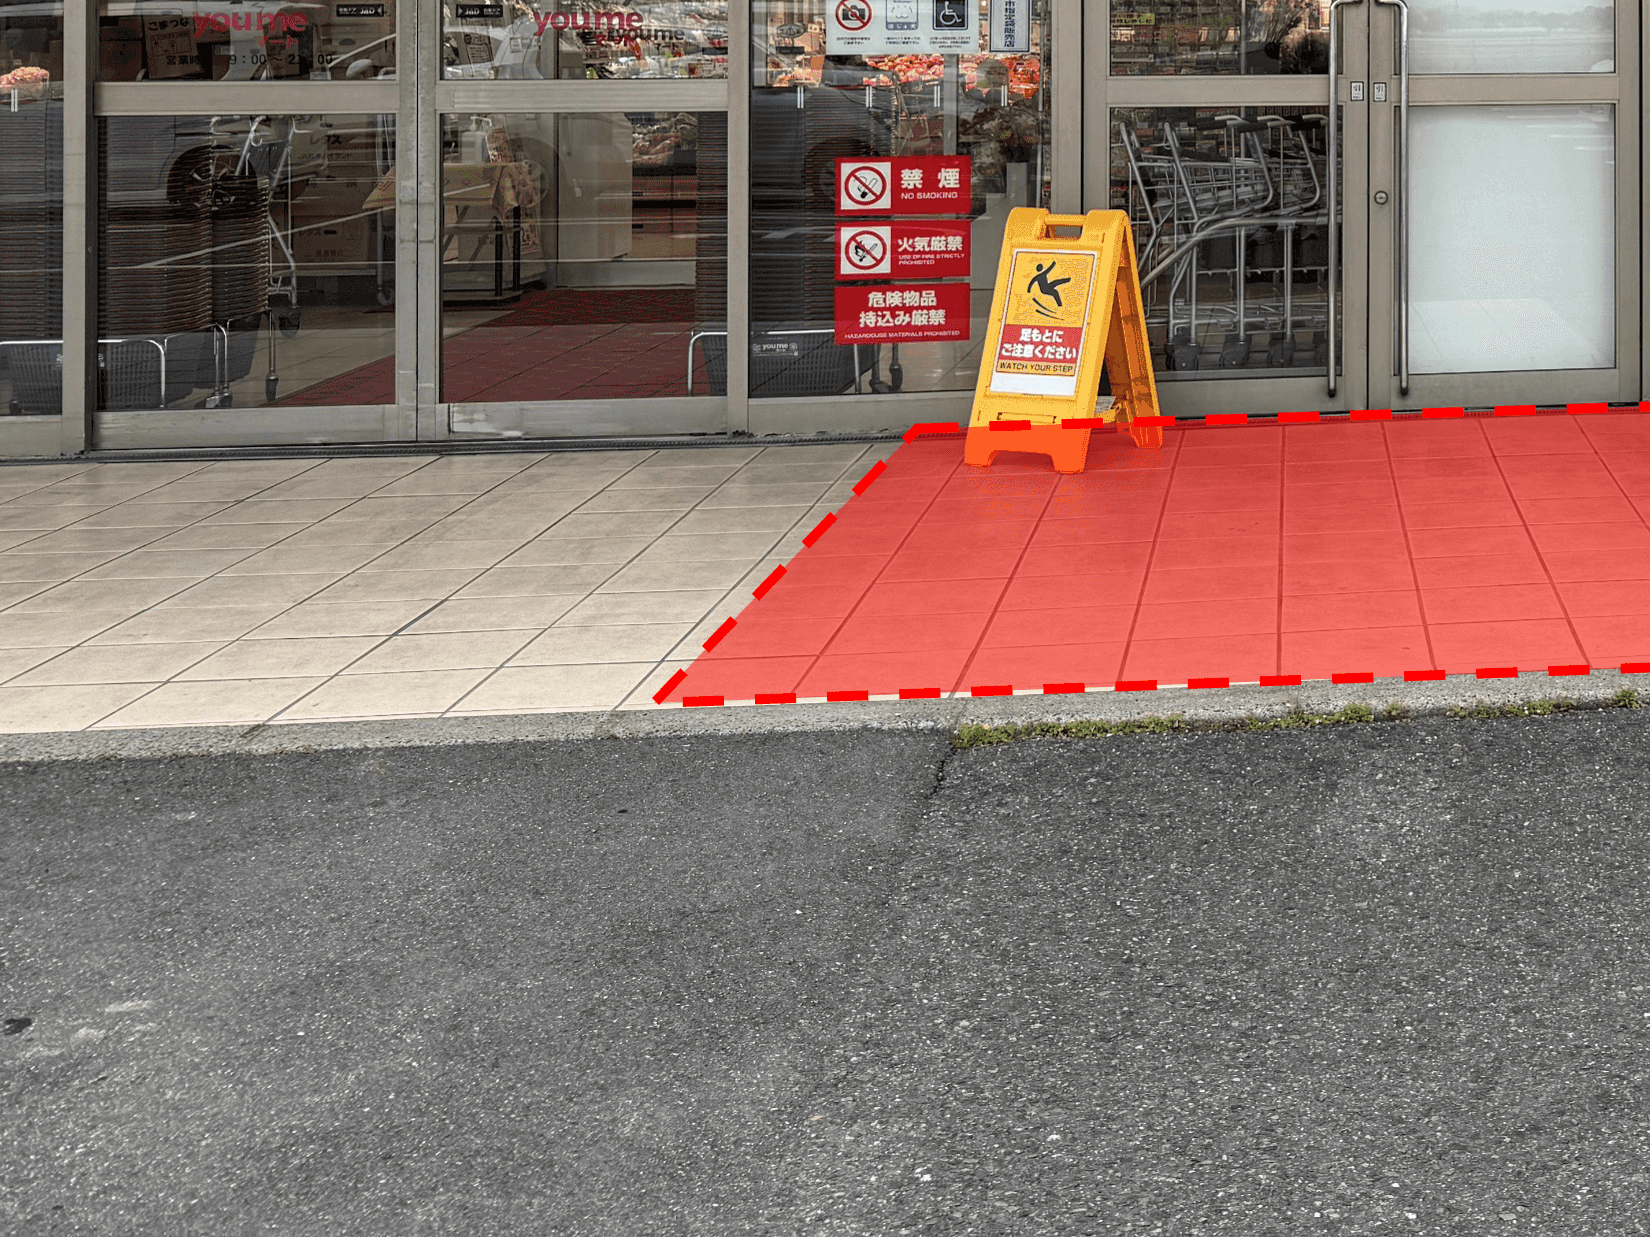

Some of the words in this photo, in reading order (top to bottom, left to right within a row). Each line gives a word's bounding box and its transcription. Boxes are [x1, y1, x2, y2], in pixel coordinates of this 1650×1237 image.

[148, 17, 190, 31] こまつな
[192, 12, 308, 38] youme
[533, 11, 643, 37] youme
[901, 168, 960, 189] 禁煙
[901, 192, 915, 200] NO
[917, 191, 959, 200] SMOKING
[897, 236, 963, 252] 火気厳禁
[868, 291, 937, 308] 危険物品
[859, 310, 946, 327] 持込み厳禁
[1019, 328, 1064, 343] 足もとに
[1001, 343, 1077, 360] ご注意ください
[1000, 362, 1028, 370] WATCH
[1030, 363, 1051, 372] YOUR
[1053, 364, 1073, 372] STEP
